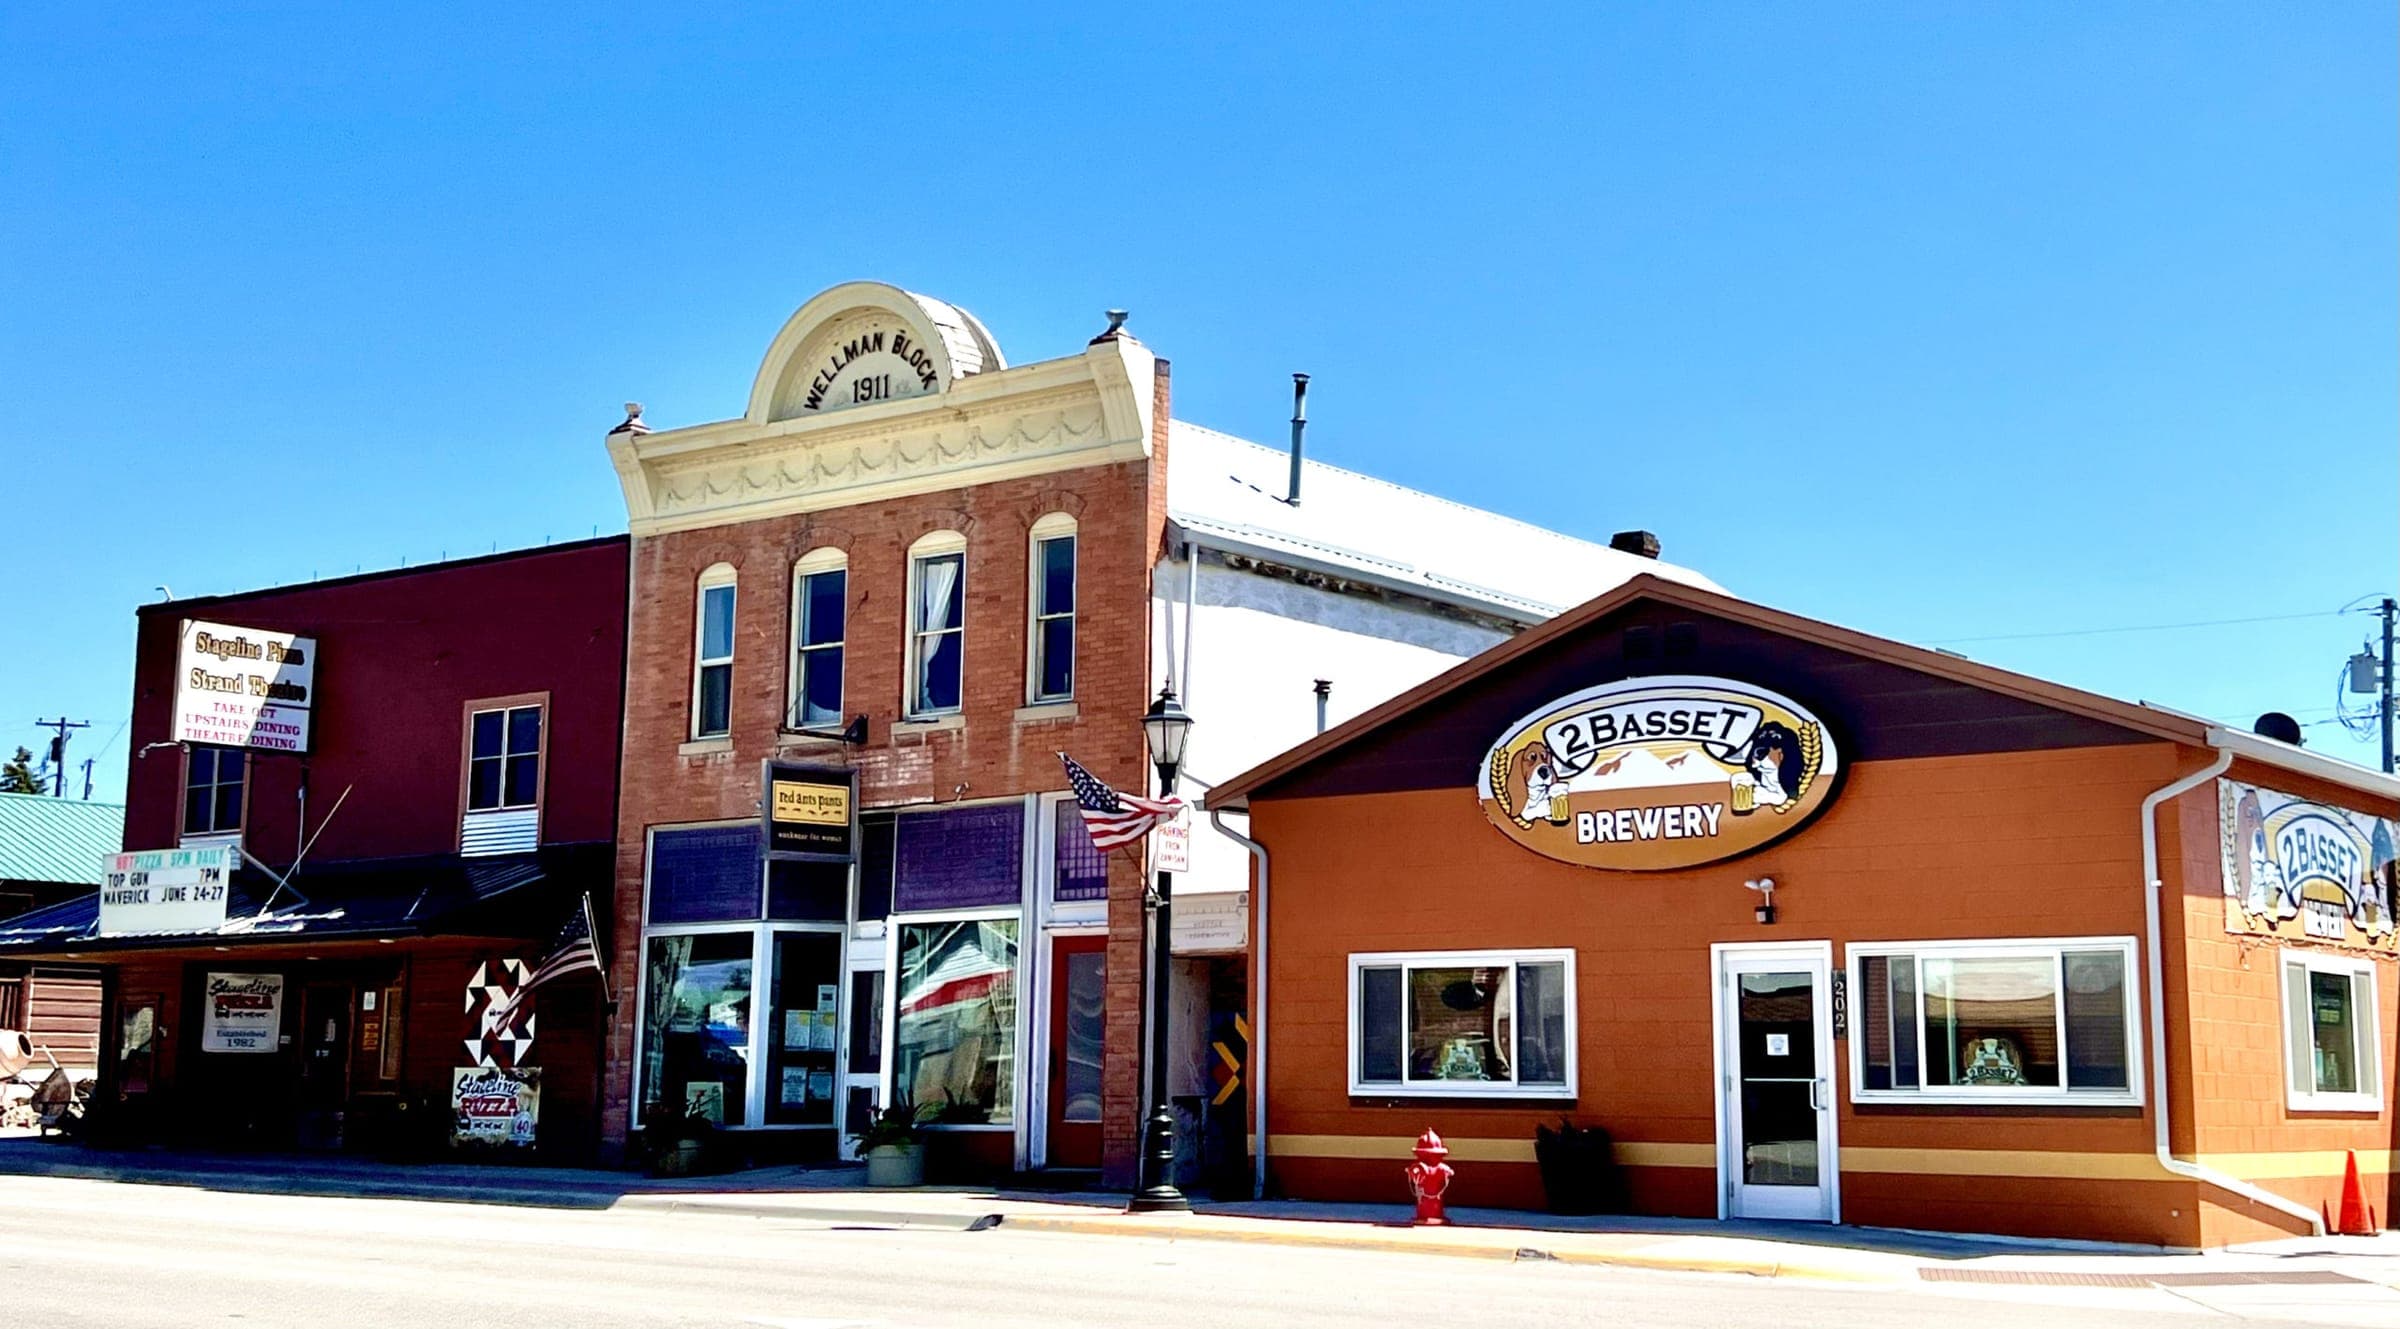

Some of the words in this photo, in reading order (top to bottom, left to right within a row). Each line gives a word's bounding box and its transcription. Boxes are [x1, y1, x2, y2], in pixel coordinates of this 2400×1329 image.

[804, 332, 884, 410] WELLMAN
[891, 334, 938, 390] BLOCK
[852, 374, 890, 403] 1911
[196, 632, 262, 661] Stageline
[190, 668, 243, 694] Strand
[213, 702, 246, 715] TAKE
[251, 707, 277, 719] OUT
[185, 713, 249, 729] UPSTAIRS
[254, 722, 301, 736] DINING
[184, 728, 246, 743] THEATRE
[251, 735, 297, 749] DINING
[779, 790, 795, 804] red
[796, 793, 817, 806] ants
[818, 795, 843, 811] pants
[1576, 803, 1723, 844] BREWERY
[107, 873, 125, 888] TOP
[130, 872, 149, 887] GUN
[104, 889, 149, 905] MAVERICK
[161, 886, 187, 902] JUNE
[193, 886, 223, 901] 24-27
[1834, 981, 1845, 1028] 202
[227, 1038, 255, 1048] 1982
